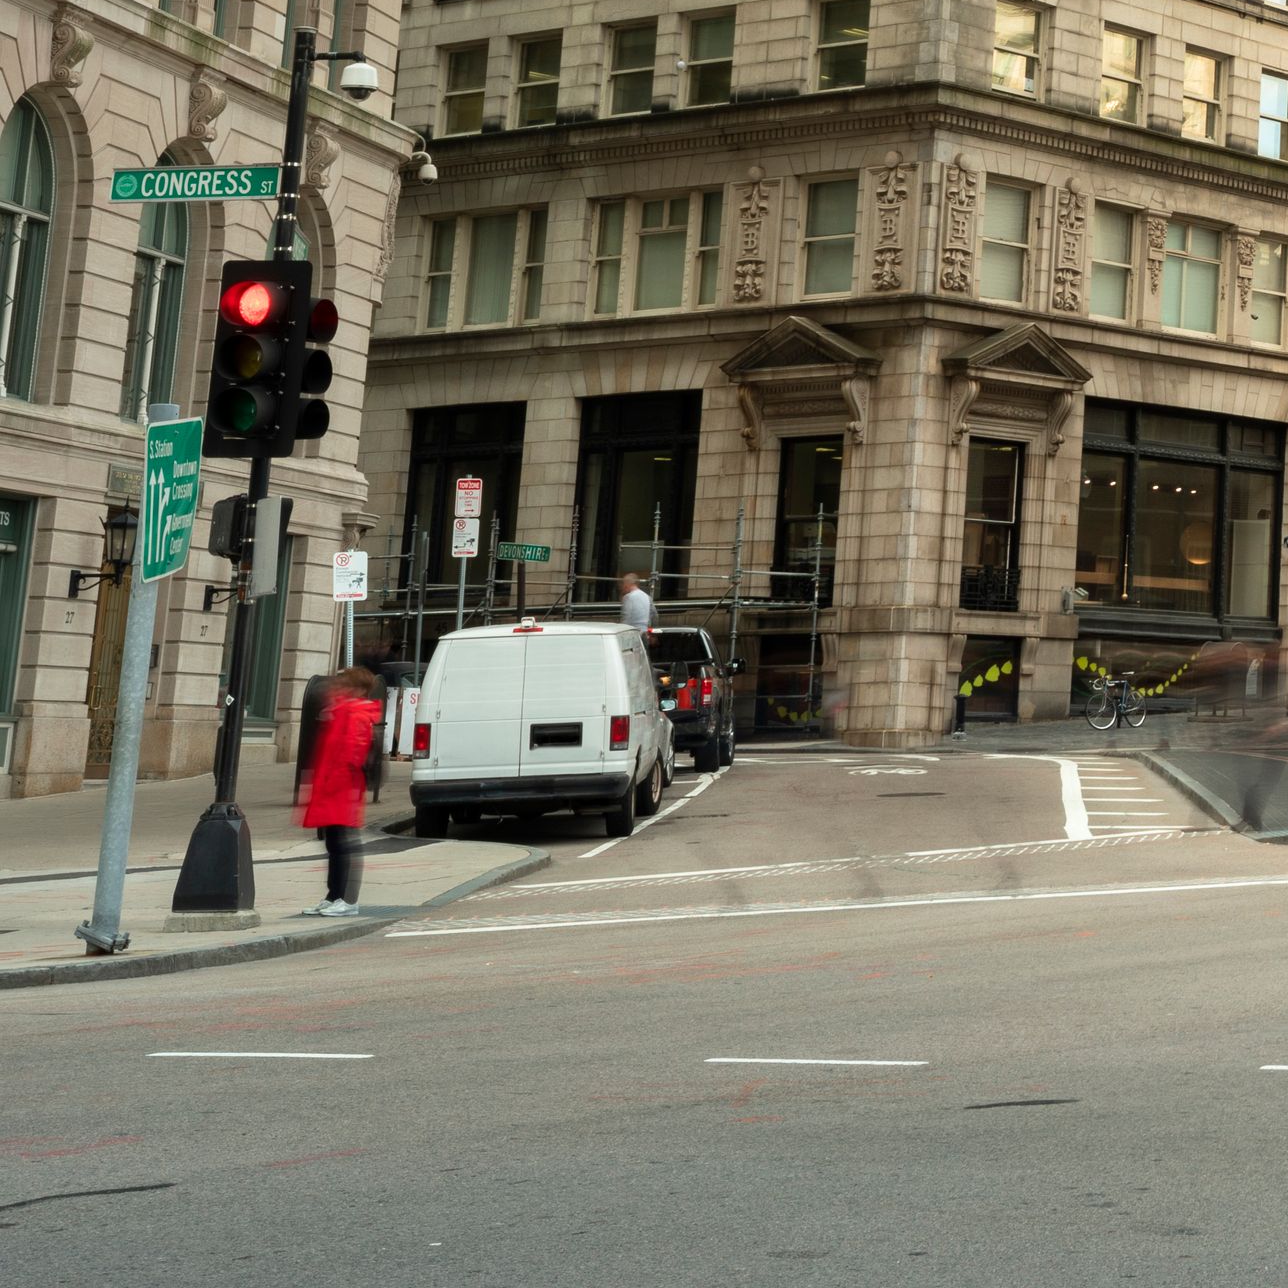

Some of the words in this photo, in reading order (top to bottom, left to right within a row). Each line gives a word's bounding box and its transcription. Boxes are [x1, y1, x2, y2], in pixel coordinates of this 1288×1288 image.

[140, 170, 253, 198] CONGRESS
[260, 180, 274, 194] ST
[150, 440, 155, 459] S.
[155, 440, 173, 458] Station
[173, 460, 197, 478] Downtown
[172, 481, 193, 501] Crossing
[499, 544, 546, 561] DEVONSHIRE
[65, 611, 75, 624] 27
[200, 625, 209, 637] 27
